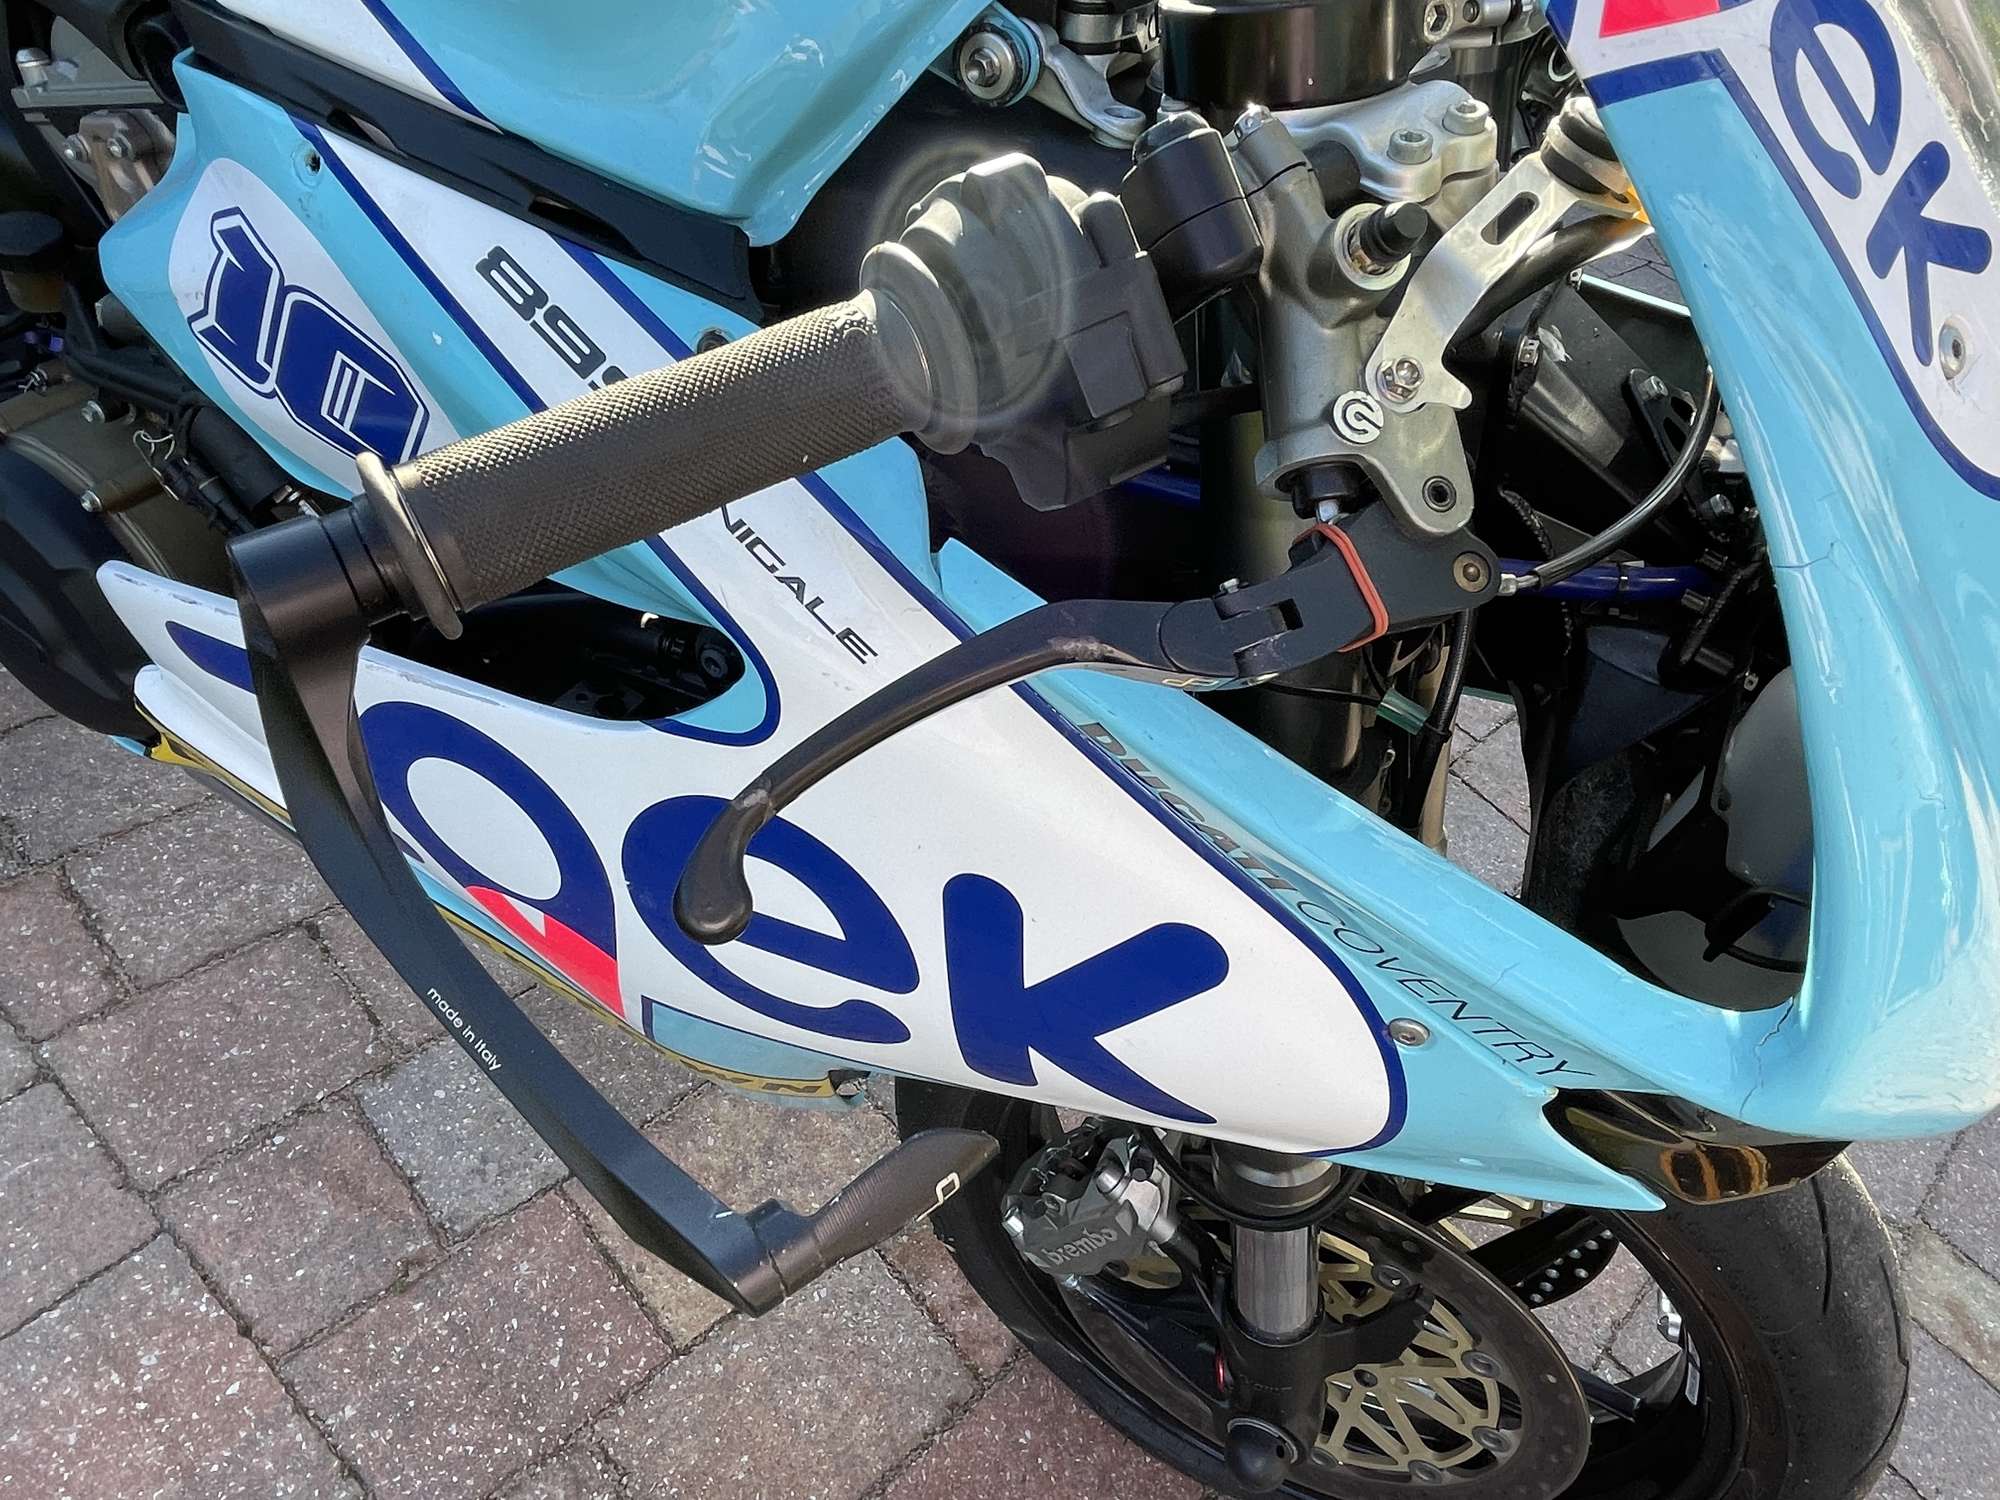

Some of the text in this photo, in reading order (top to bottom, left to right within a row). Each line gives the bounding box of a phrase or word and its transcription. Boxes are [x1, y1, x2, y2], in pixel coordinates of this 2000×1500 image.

[475, 245, 630, 392] 89
[1076, 722, 1596, 1077] DUCATI COVENTRY
[426, 987, 502, 1071] made in Italy
[1041, 1224, 1118, 1265] brembo
